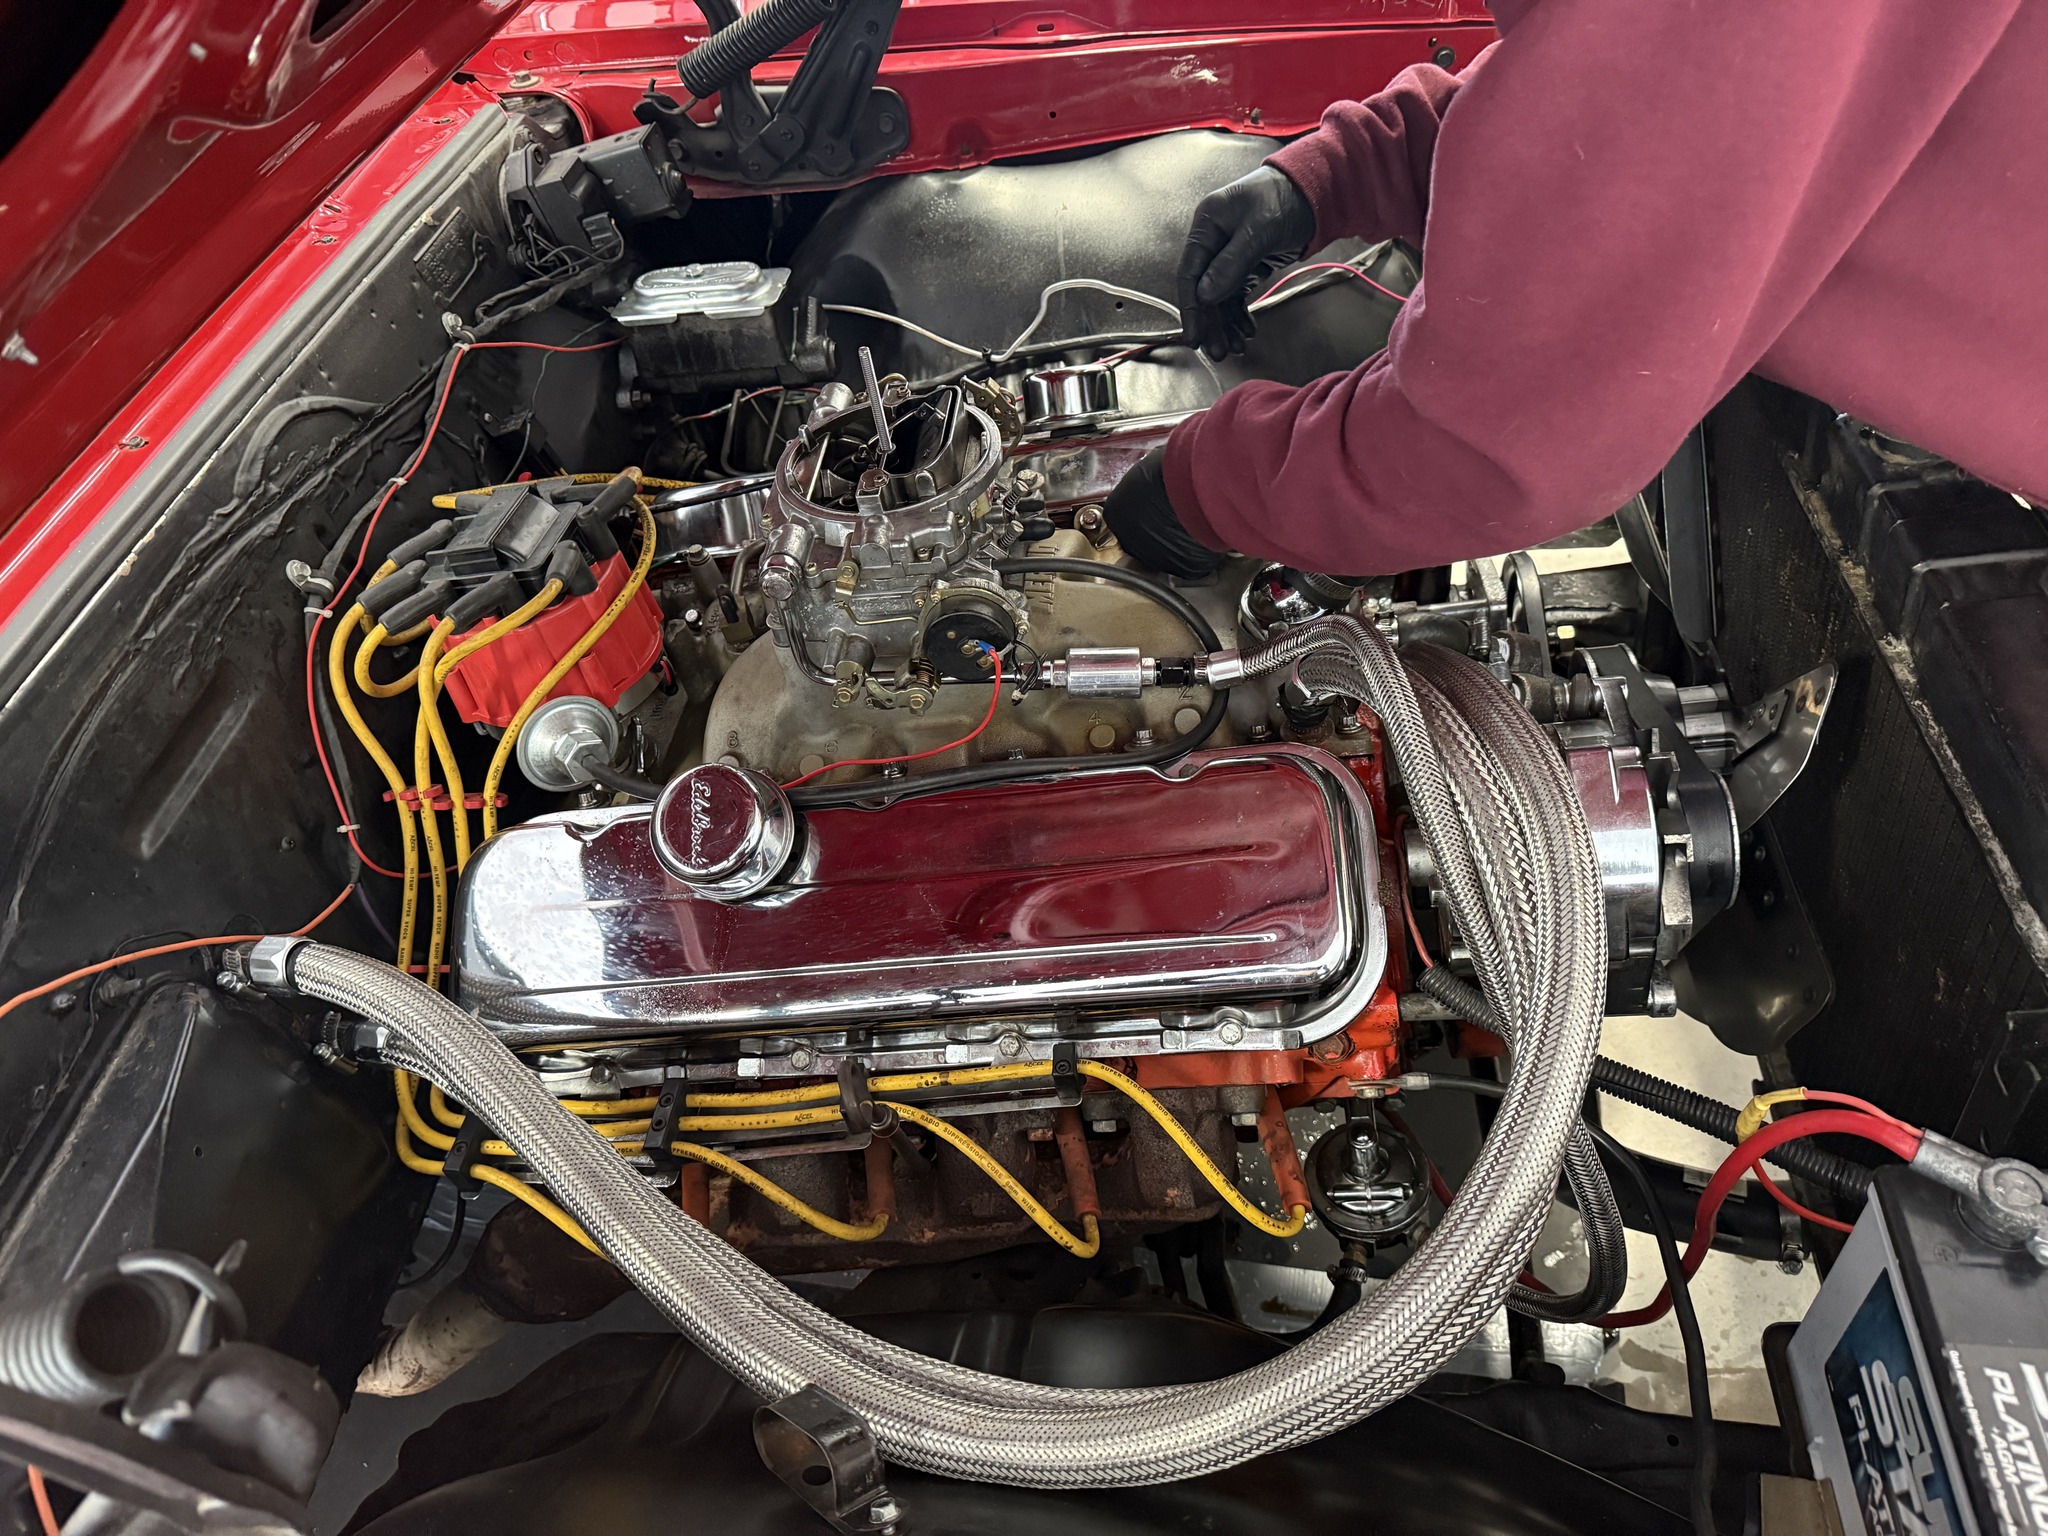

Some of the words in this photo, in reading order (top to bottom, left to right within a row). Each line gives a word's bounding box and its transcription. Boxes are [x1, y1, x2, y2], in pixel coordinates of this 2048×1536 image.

[727, 730, 739, 748] 8
[1088, 710, 1101, 725] 4
[710, 1159, 729, 1171] CORE
[750, 1182, 765, 1193] WIRE
[895, 1106, 916, 1118] STOCK
[920, 1114, 940, 1128] RADIO
[943, 1126, 985, 1161] SUPPRESSION
[987, 1162, 1004, 1180] CORE
[1021, 1197, 1038, 1214] WIRE
[1100, 1065, 1123, 1079] SUPER
[1125, 1078, 1147, 1095] STOCK
[1152, 1099, 1169, 1117] RADIO
[1170, 1117, 1206, 1159] SUPPRESSION
[1206, 1159, 1221, 1177] CORE
[1236, 1194, 1250, 1209] WIRE
[1848, 1394, 1896, 1536] PLAT
[1983, 1367, 2048, 1536] PLATINU
